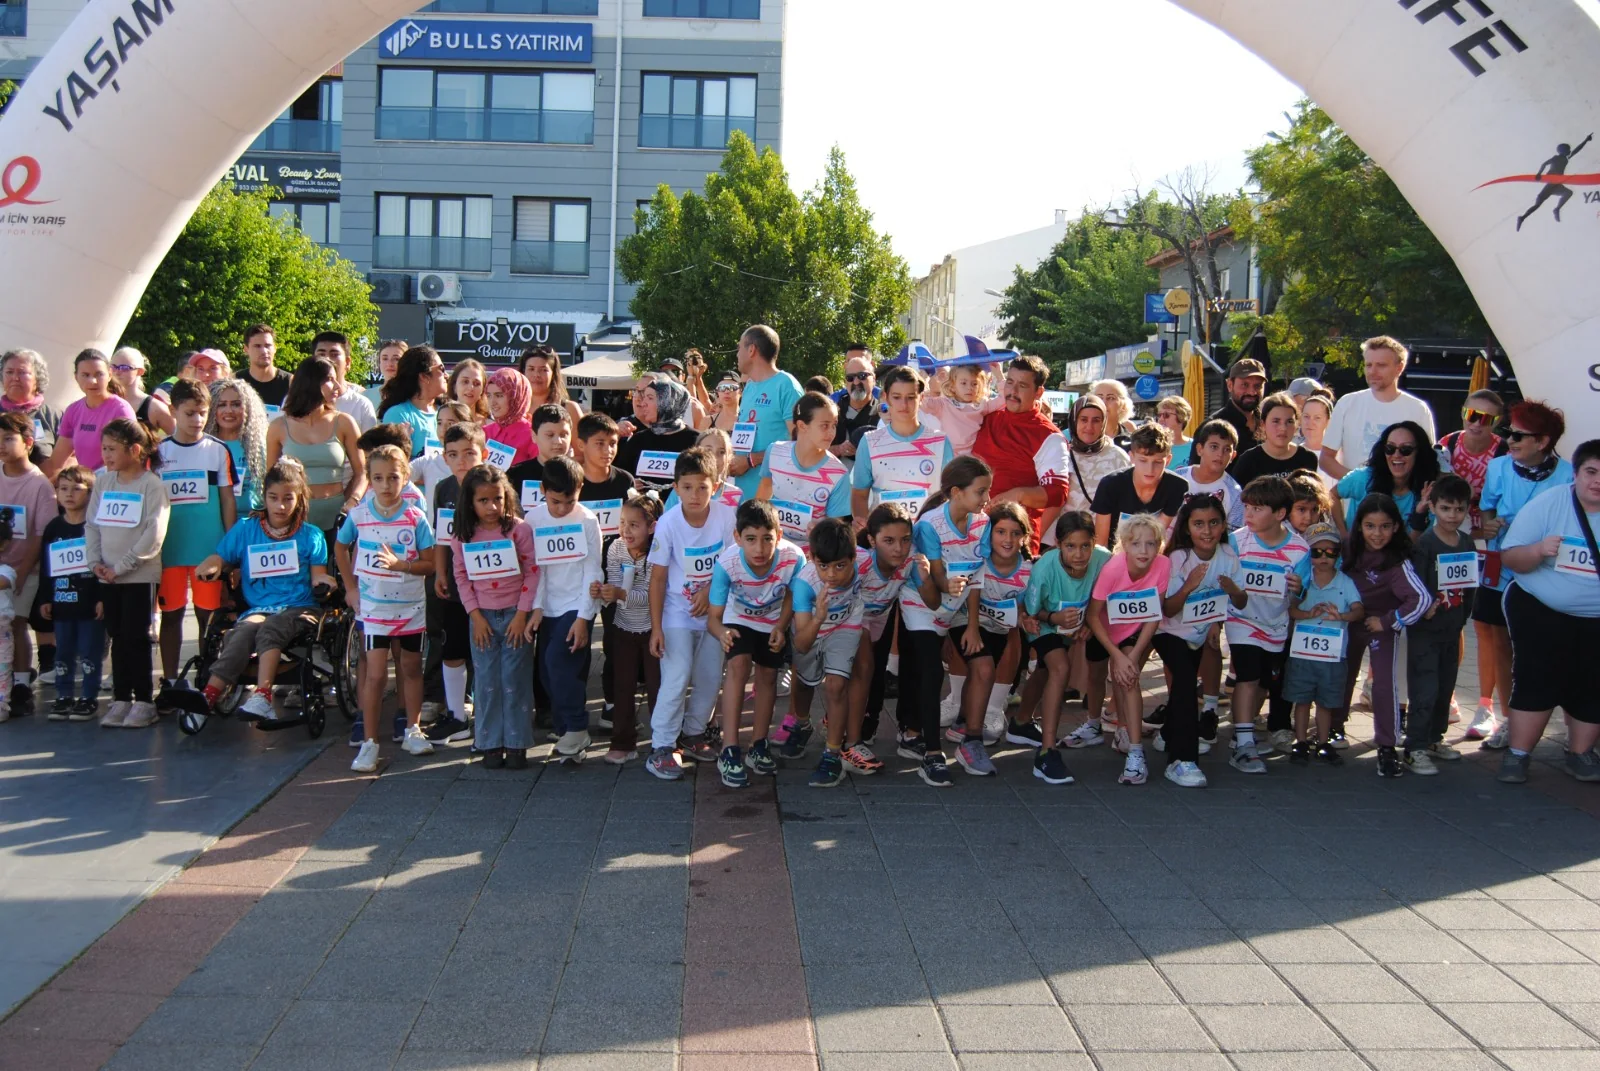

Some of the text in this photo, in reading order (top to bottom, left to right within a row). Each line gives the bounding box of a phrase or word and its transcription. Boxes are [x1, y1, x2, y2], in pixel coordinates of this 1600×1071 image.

[429, 32, 583, 51] BULLS YATIRIM
[1397, 0, 1529, 77] FE
[42, 0, 175, 133] YAŞAM
[278, 166, 313, 180] Beauty
[7, 211, 29, 227] İÇİN
[32, 215, 67, 228] YARIŞ
[458, 323, 549, 344] FOR YOU
[478, 344, 525, 363] Boutiqu
[566, 376, 598, 387] BAKKU
[735, 433, 750, 445] 227
[487, 450, 505, 465] 126
[647, 459, 670, 471] 229
[171, 481, 197, 495] 042
[105, 502, 129, 516] 107
[595, 511, 611, 524] 17
[777, 509, 801, 525] 083
[546, 536, 576, 553] 006
[58, 549, 84, 564] 109
[260, 553, 287, 568] 010
[364, 553, 384, 568] 12
[474, 553, 503, 569] 113
[1446, 564, 1468, 579] 096
[1245, 572, 1273, 587] 081
[979, 604, 1006, 621] 082
[1118, 601, 1148, 615] 068
[1192, 600, 1216, 617] 122
[1302, 636, 1330, 651] 163
